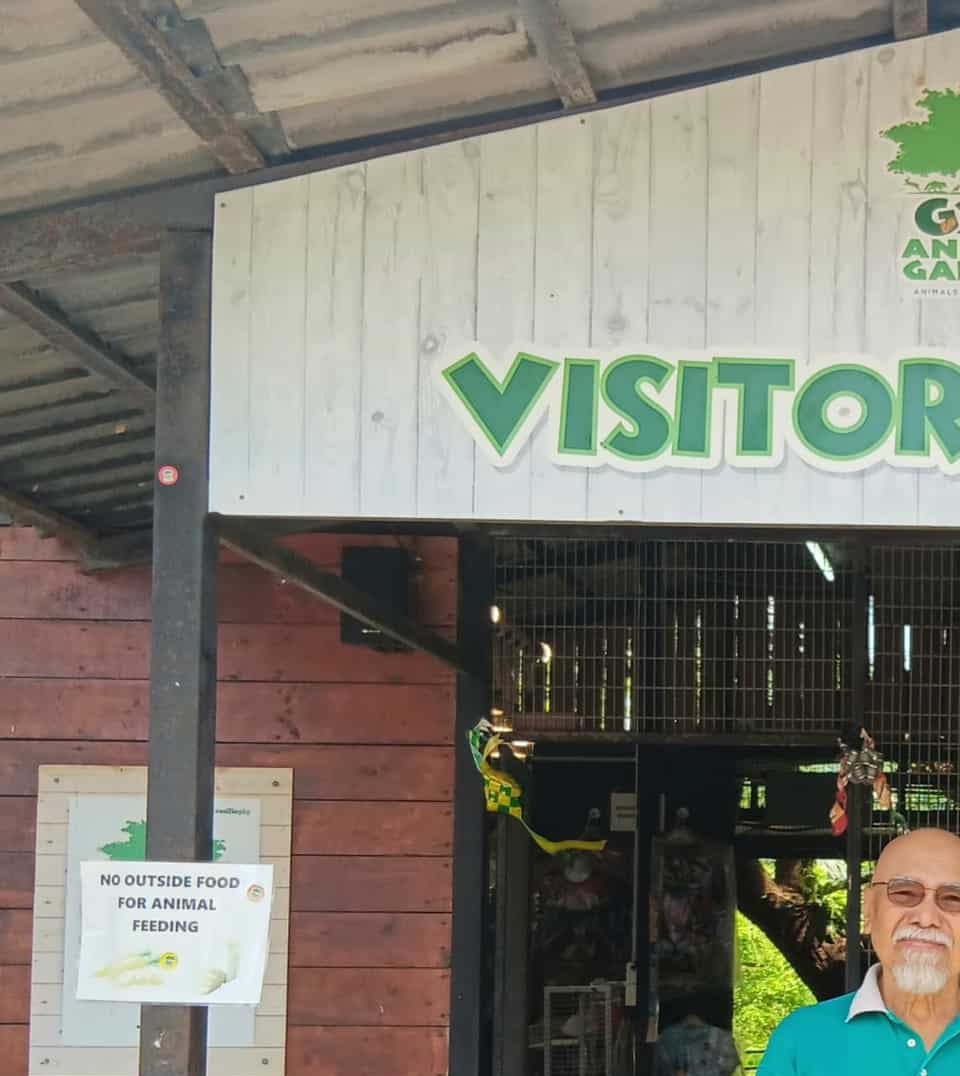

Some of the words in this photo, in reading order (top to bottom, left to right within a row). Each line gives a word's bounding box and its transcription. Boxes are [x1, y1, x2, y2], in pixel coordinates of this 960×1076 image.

[913, 287, 958, 297] ANIMALS
[100, 874, 121, 886] NO
[124, 874, 193, 888] OUTSIDE
[196, 876, 241, 889] FOOD
[118, 897, 147, 909] FOR
[151, 897, 217, 911] ANIMAL
[132, 919, 200, 933] FEEDING
